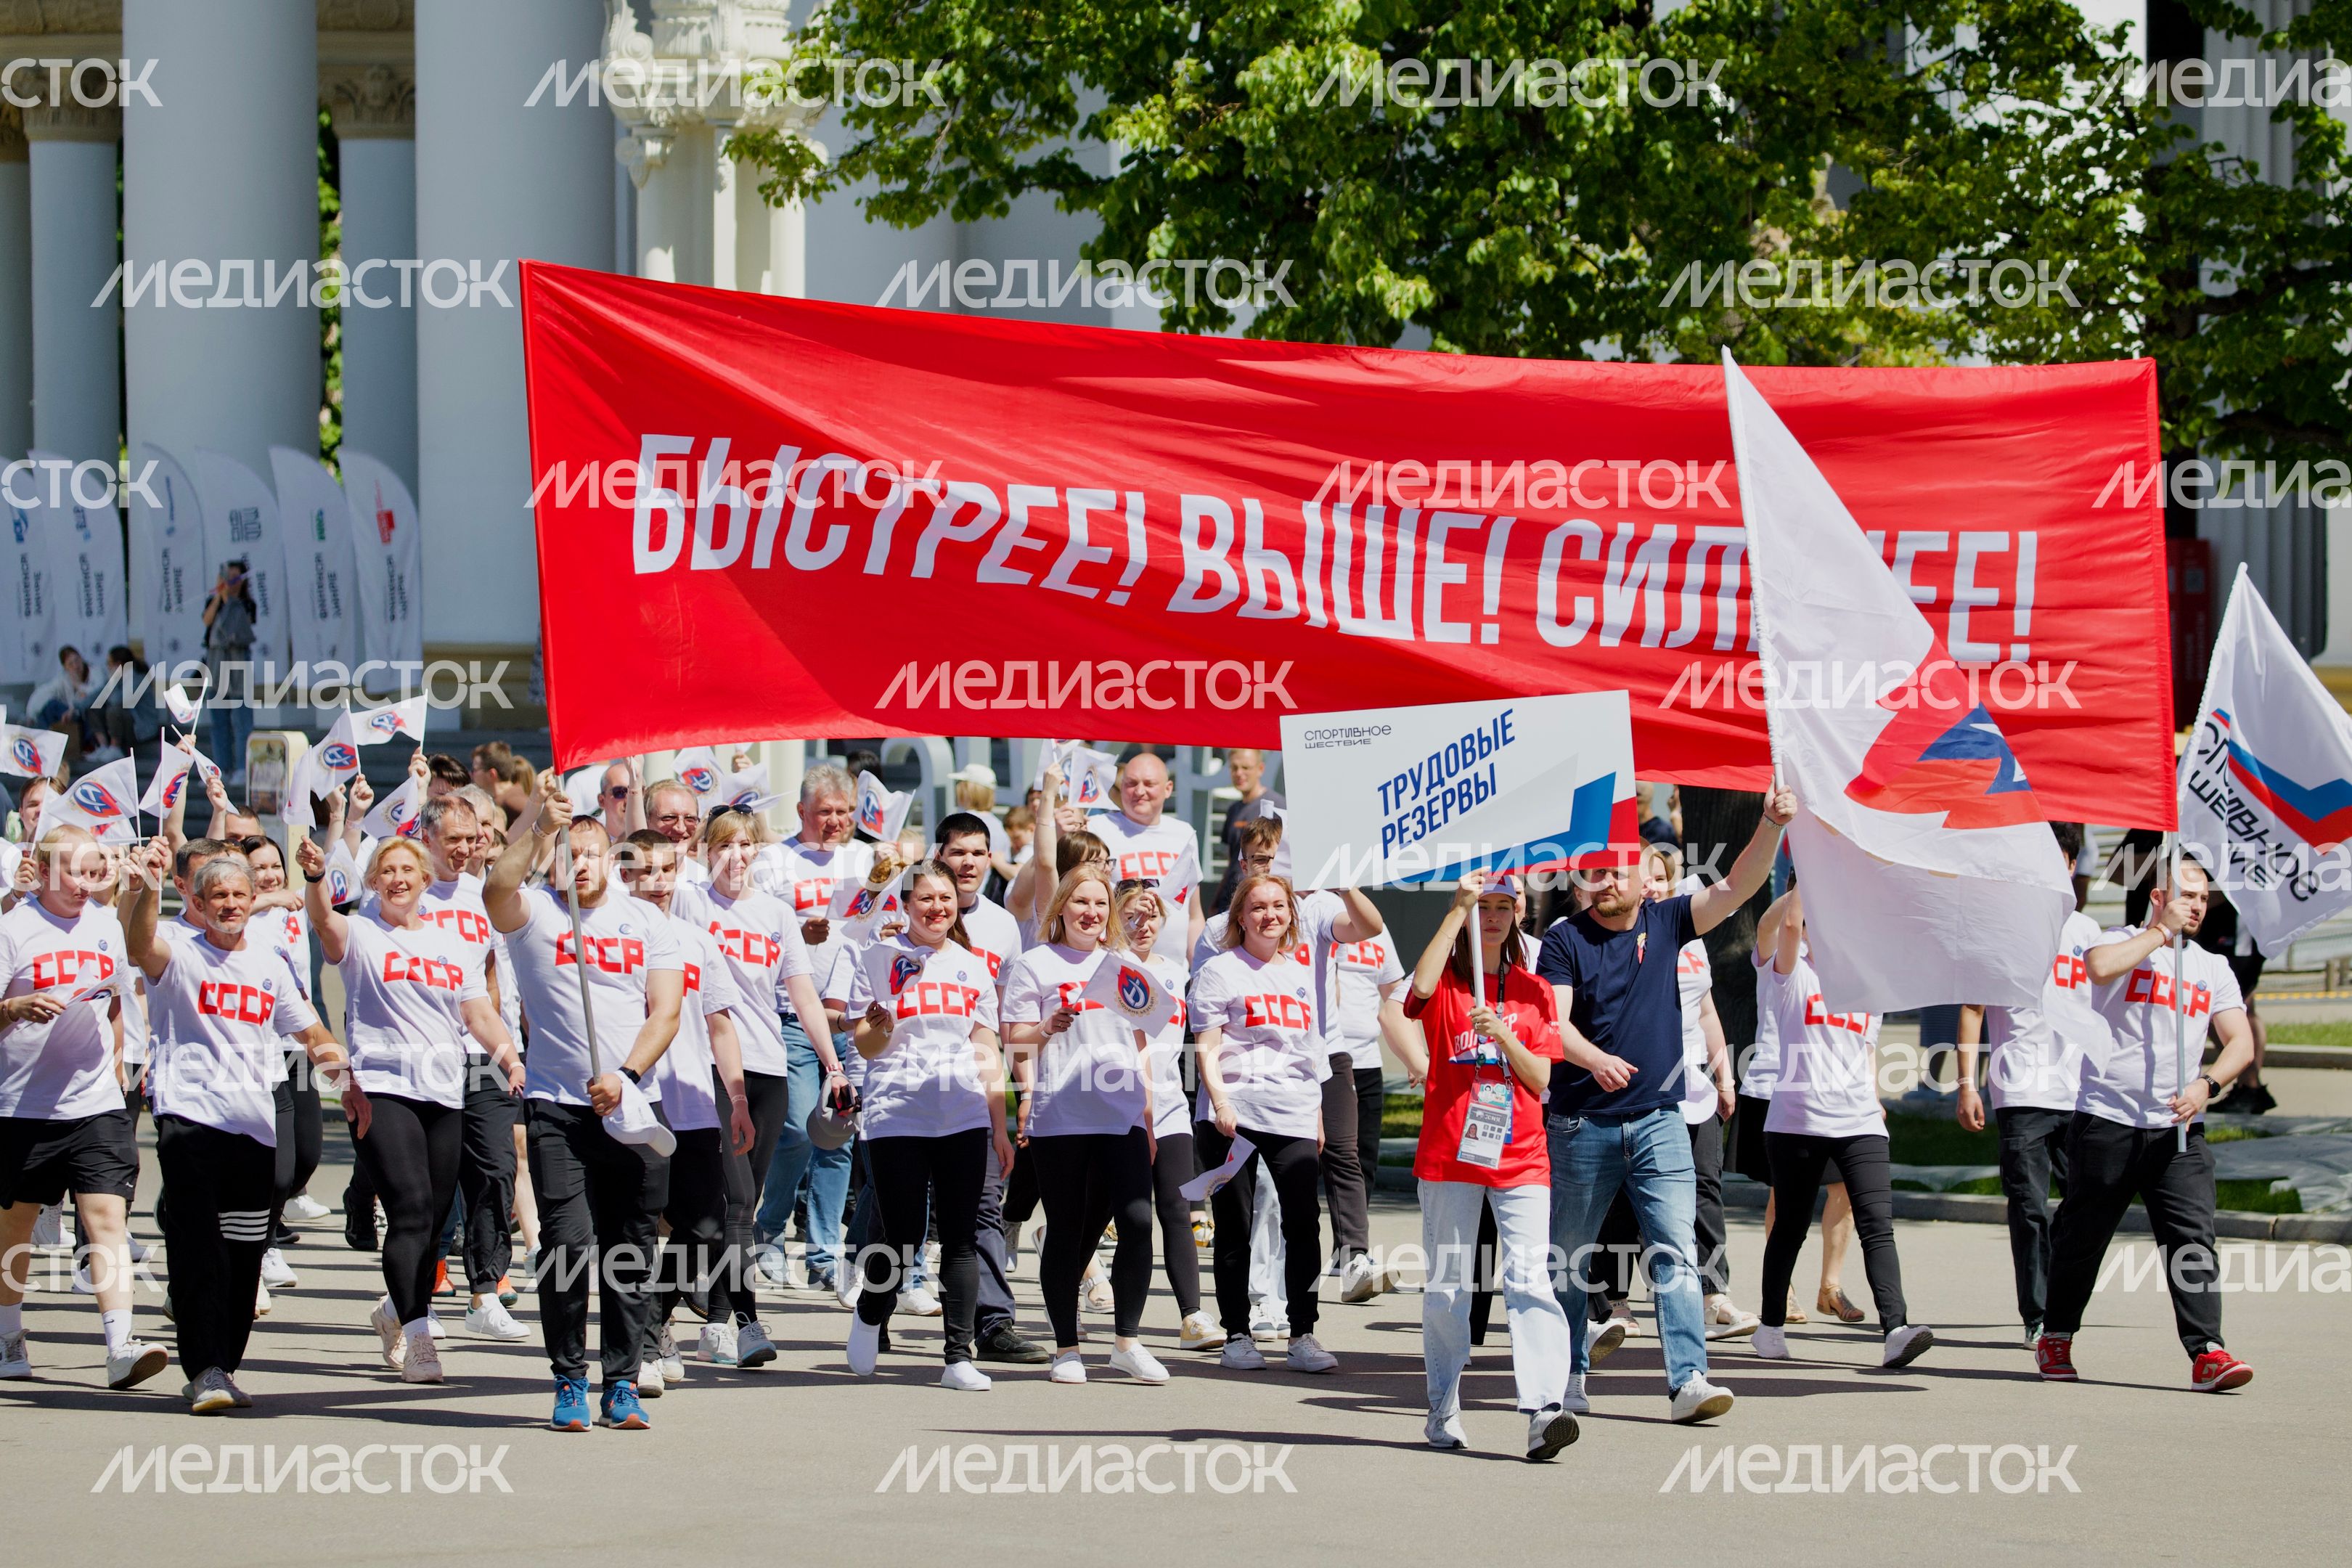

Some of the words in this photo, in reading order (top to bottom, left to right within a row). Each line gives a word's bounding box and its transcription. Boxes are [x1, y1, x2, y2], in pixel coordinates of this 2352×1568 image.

[633, 434, 1148, 606] БЫСТРЕЕ!
[1166, 493, 1516, 645] ВЫШЕ!
[1535, 518, 2038, 663] СИЛЕЕ!
[1304, 738, 1372, 749] ШЕСТВИЕ
[1378, 709, 1516, 817] ТРУДОВЫЕ
[1381, 762, 1497, 860] РЕЗЕРВЫ
[1120, 852, 1180, 880] ССС
[197, 980, 276, 1026] СССР
